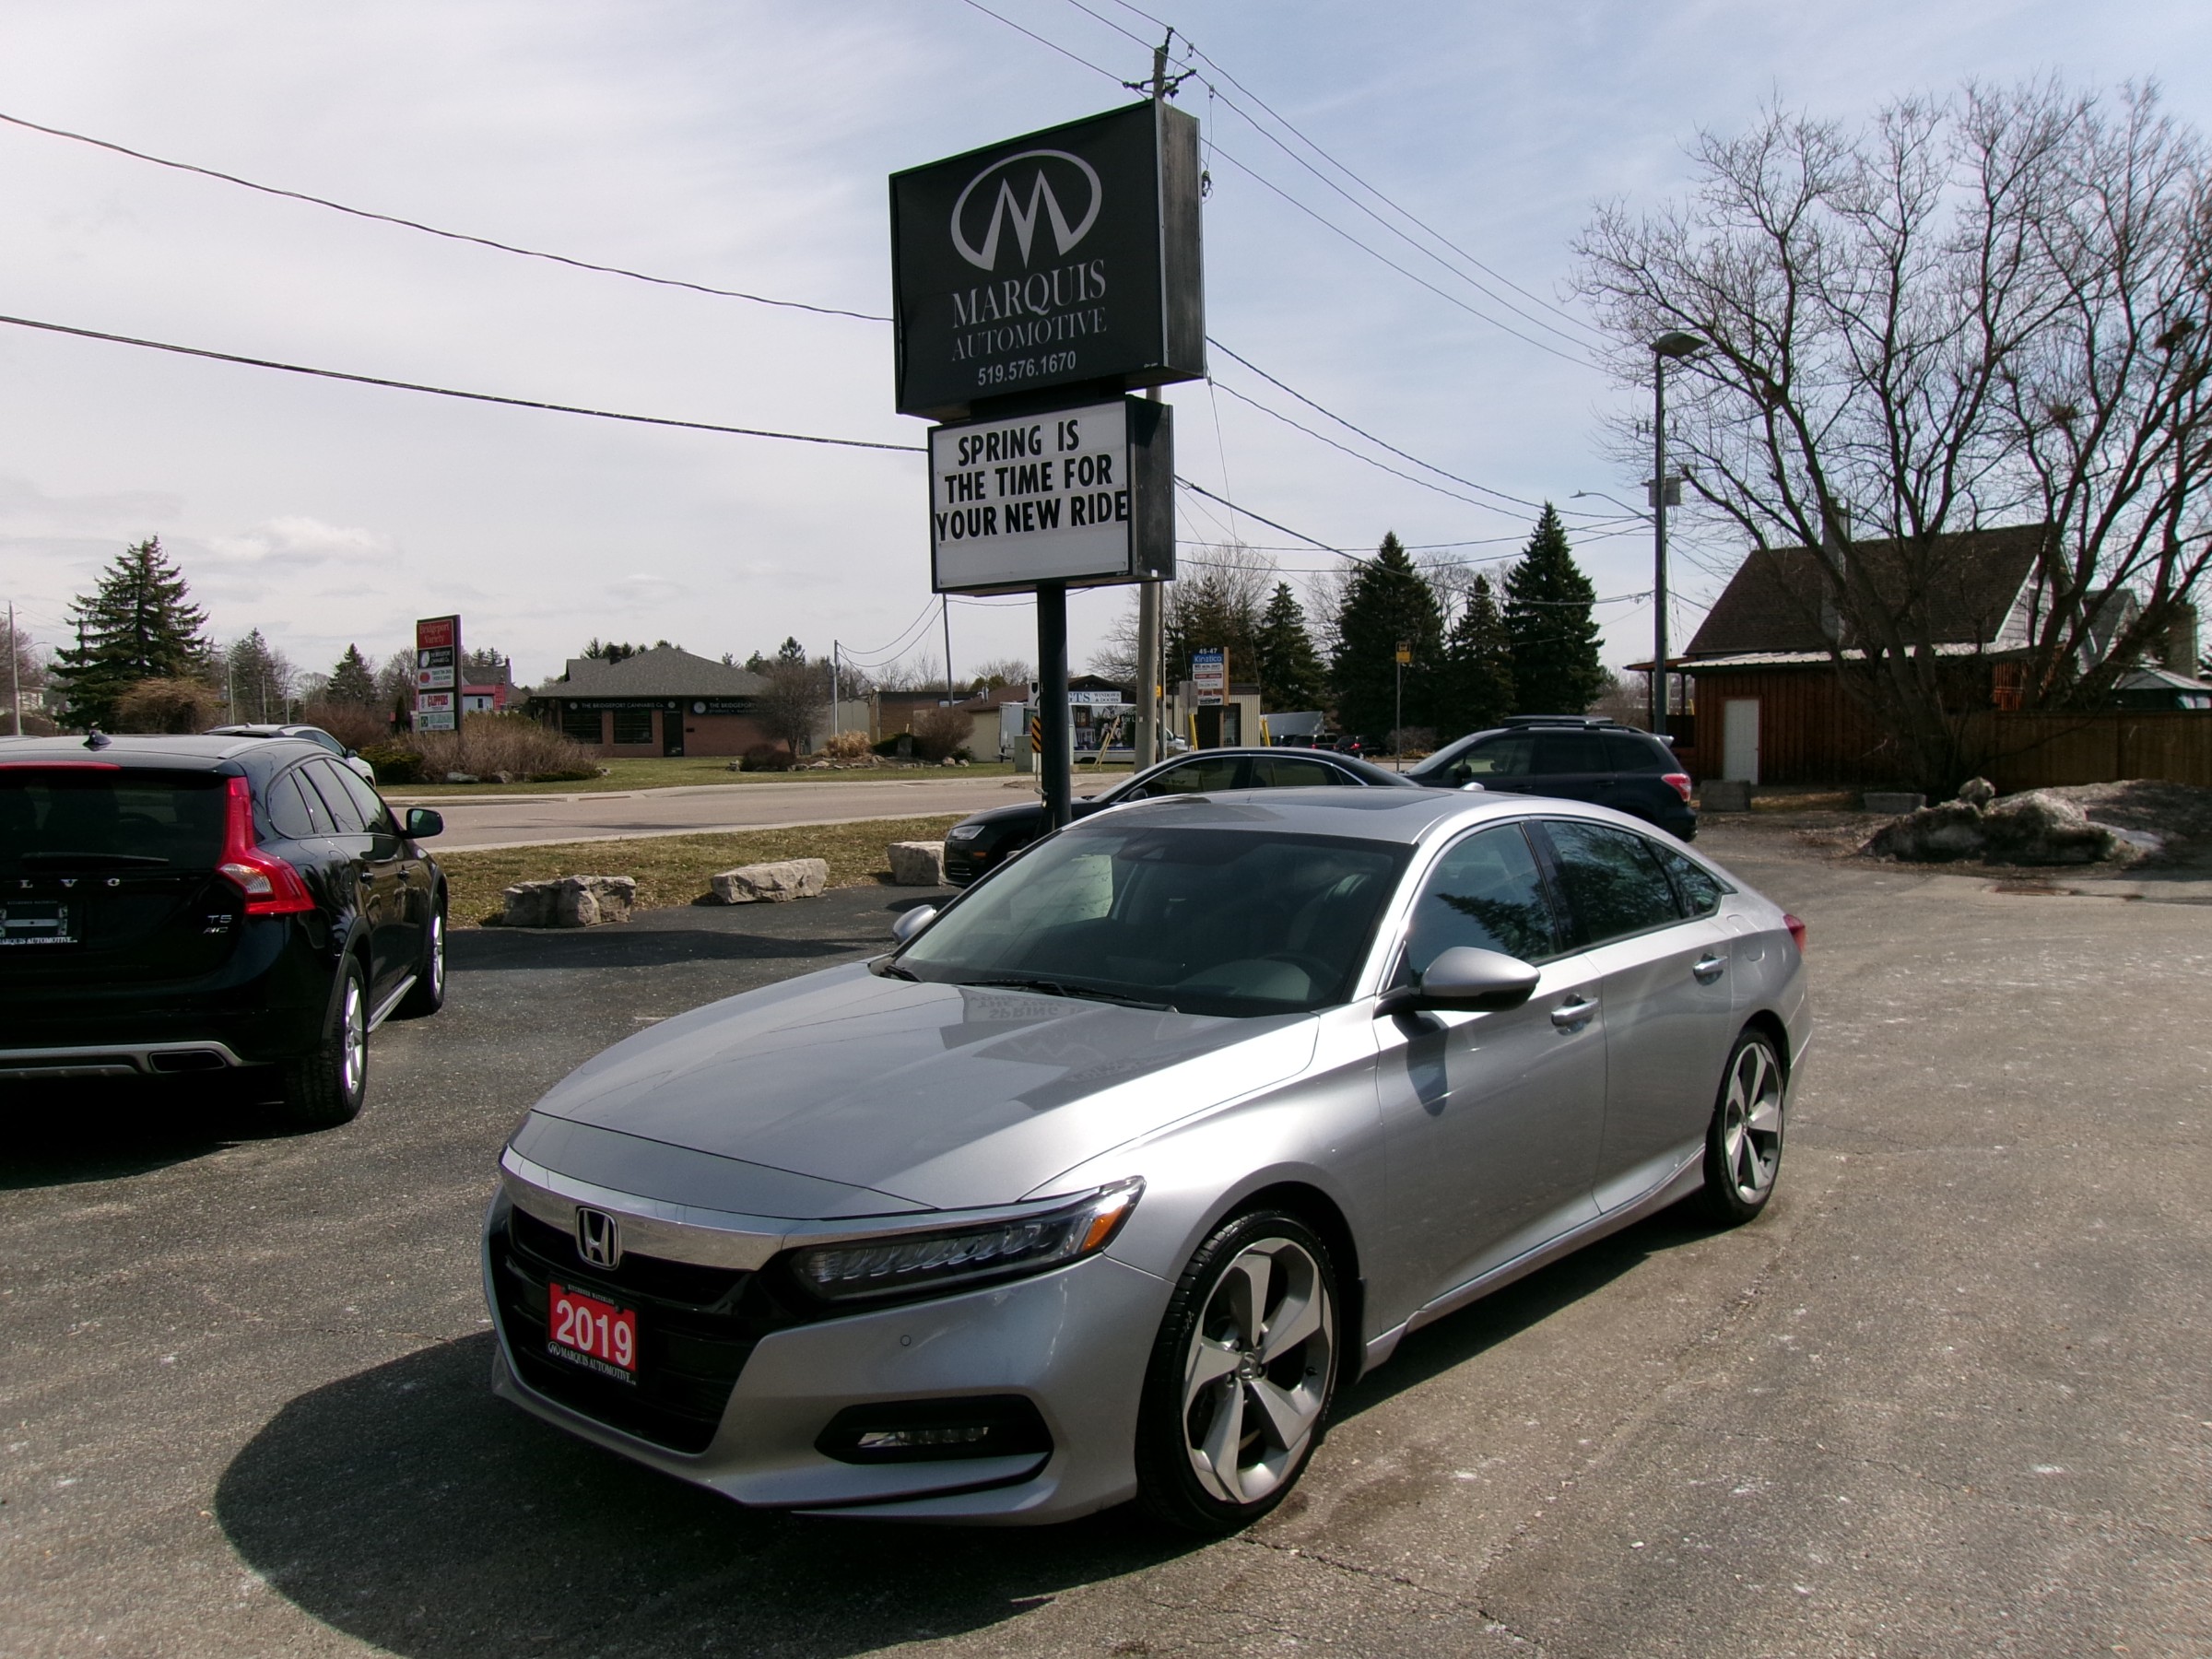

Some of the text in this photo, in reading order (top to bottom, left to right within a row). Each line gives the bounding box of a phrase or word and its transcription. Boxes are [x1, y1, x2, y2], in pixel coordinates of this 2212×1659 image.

[952, 259, 1106, 329] MARQUIS
[952, 307, 1107, 361] AUTOMOTIVE
[978, 350, 1077, 386] 519.576.1670
[959, 419, 1079, 466] SPRING IS
[945, 453, 1112, 504] THE TIME FOR
[935, 490, 1128, 541] YOUR NEW RIDE
[419, 622, 450, 635] Bridgeport
[424, 634, 444, 645] Variety
[207, 914, 232, 924] T5
[557, 1300, 632, 1366] 2019
[561, 1347, 588, 1366] MARQUIS
